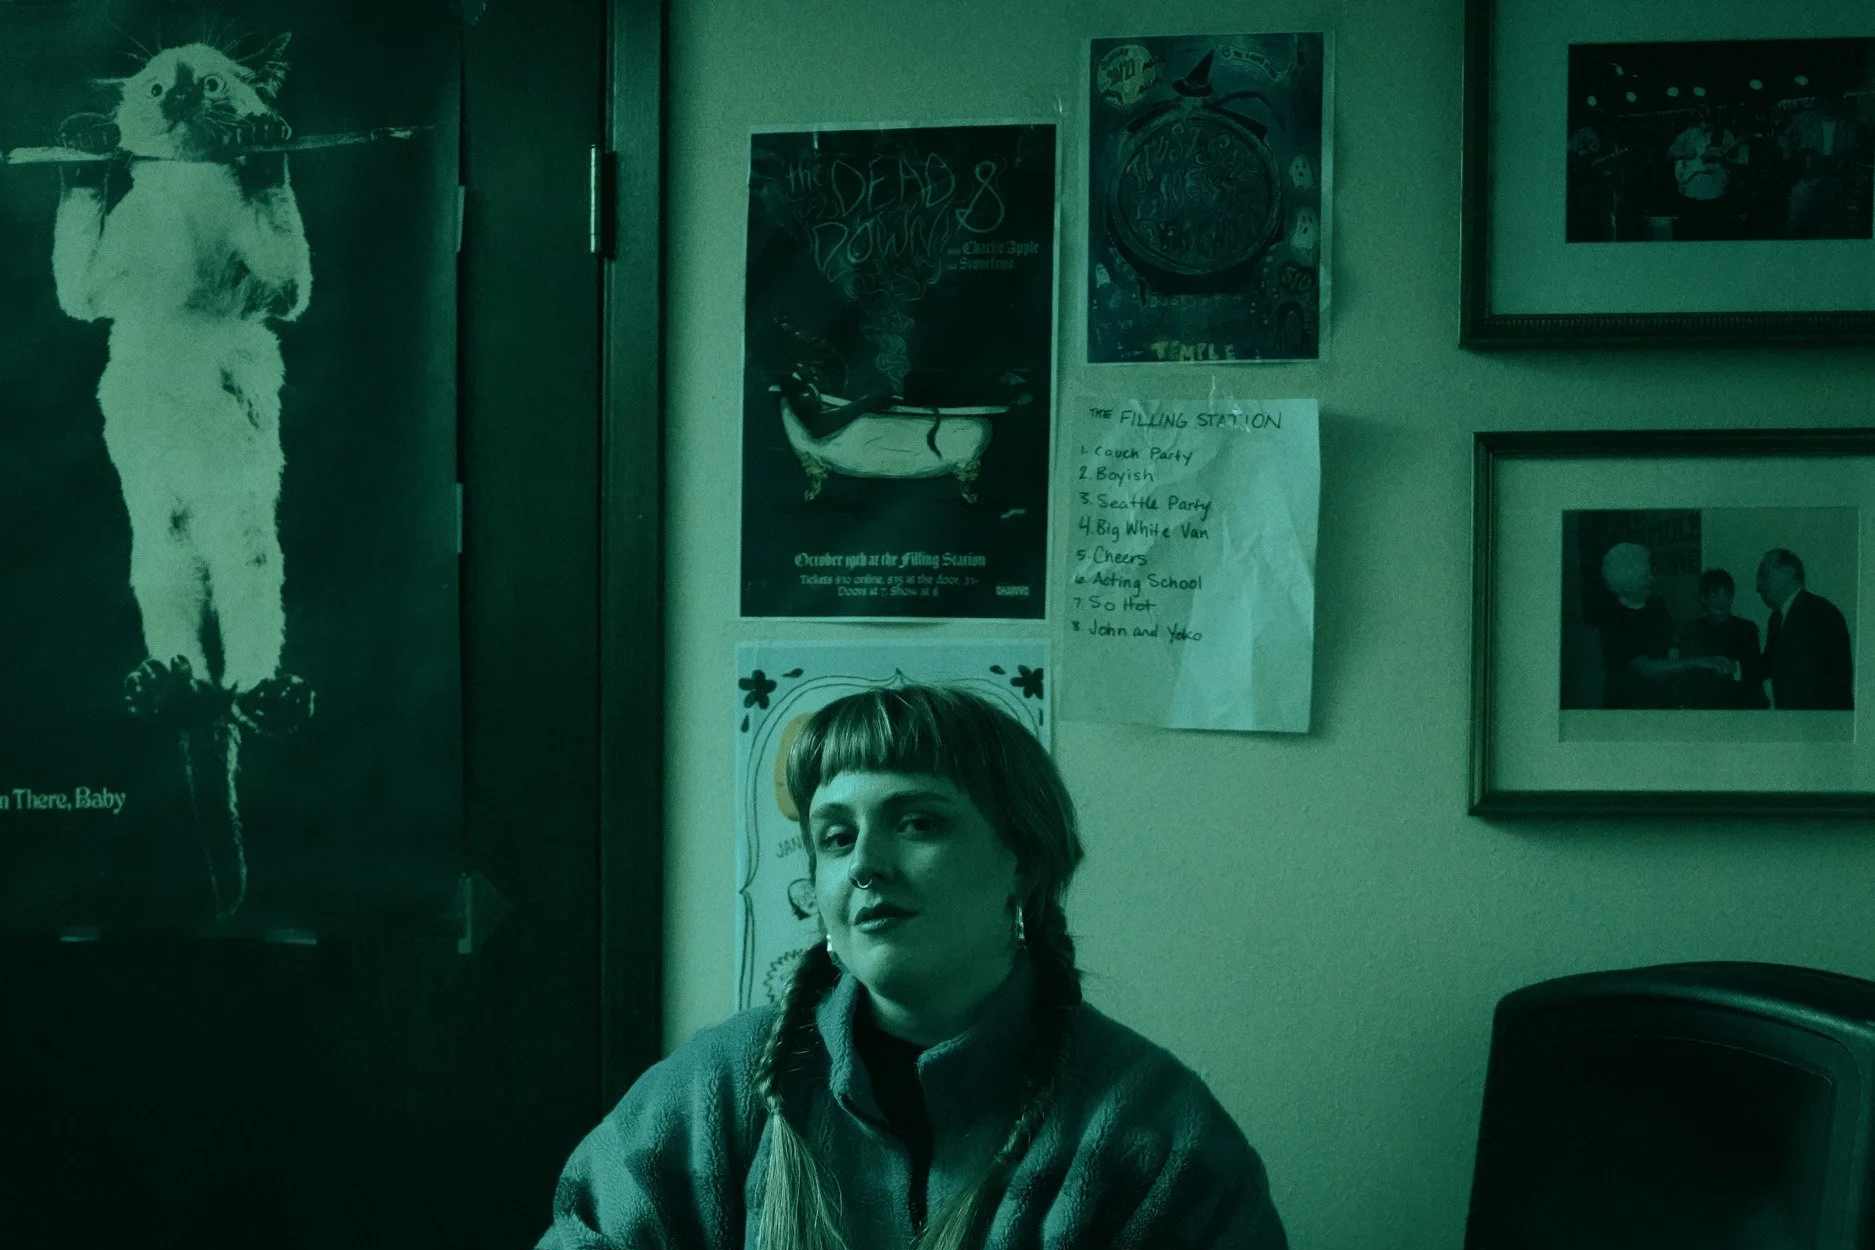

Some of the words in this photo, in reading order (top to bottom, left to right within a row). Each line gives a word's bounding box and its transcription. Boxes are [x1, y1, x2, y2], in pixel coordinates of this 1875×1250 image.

[831, 152, 956, 217] DEAD
[1119, 410, 1188, 429] FILLING
[1196, 412, 1282, 429] STATION
[1149, 447, 1194, 466] Party
[1078, 467, 1091, 480] 2.
[1096, 466, 1153, 485] Boyish
[1079, 491, 1093, 505] 3.
[1097, 493, 1159, 511] Seattle
[1168, 495, 1213, 521] Party
[1078, 514, 1094, 536] 4.
[1096, 518, 1120, 542] Big
[1126, 519, 1172, 538] White
[1181, 523, 1209, 539] Van
[795, 553, 842, 567] October
[881, 553, 897, 566] the
[899, 552, 939, 569] Filling
[942, 553, 986, 567] Station
[1093, 545, 1147, 566] Cheers
[1091, 573, 1142, 596] Acting
[1147, 575, 1202, 590] School
[1089, 596, 1116, 612] So
[1123, 598, 1157, 612] Hot
[1089, 620, 1127, 638] John
[1133, 625, 1158, 638] and
[1167, 624, 1202, 643] Yoko
[12, 788, 72, 811] There,
[75, 786, 126, 814] Baby
